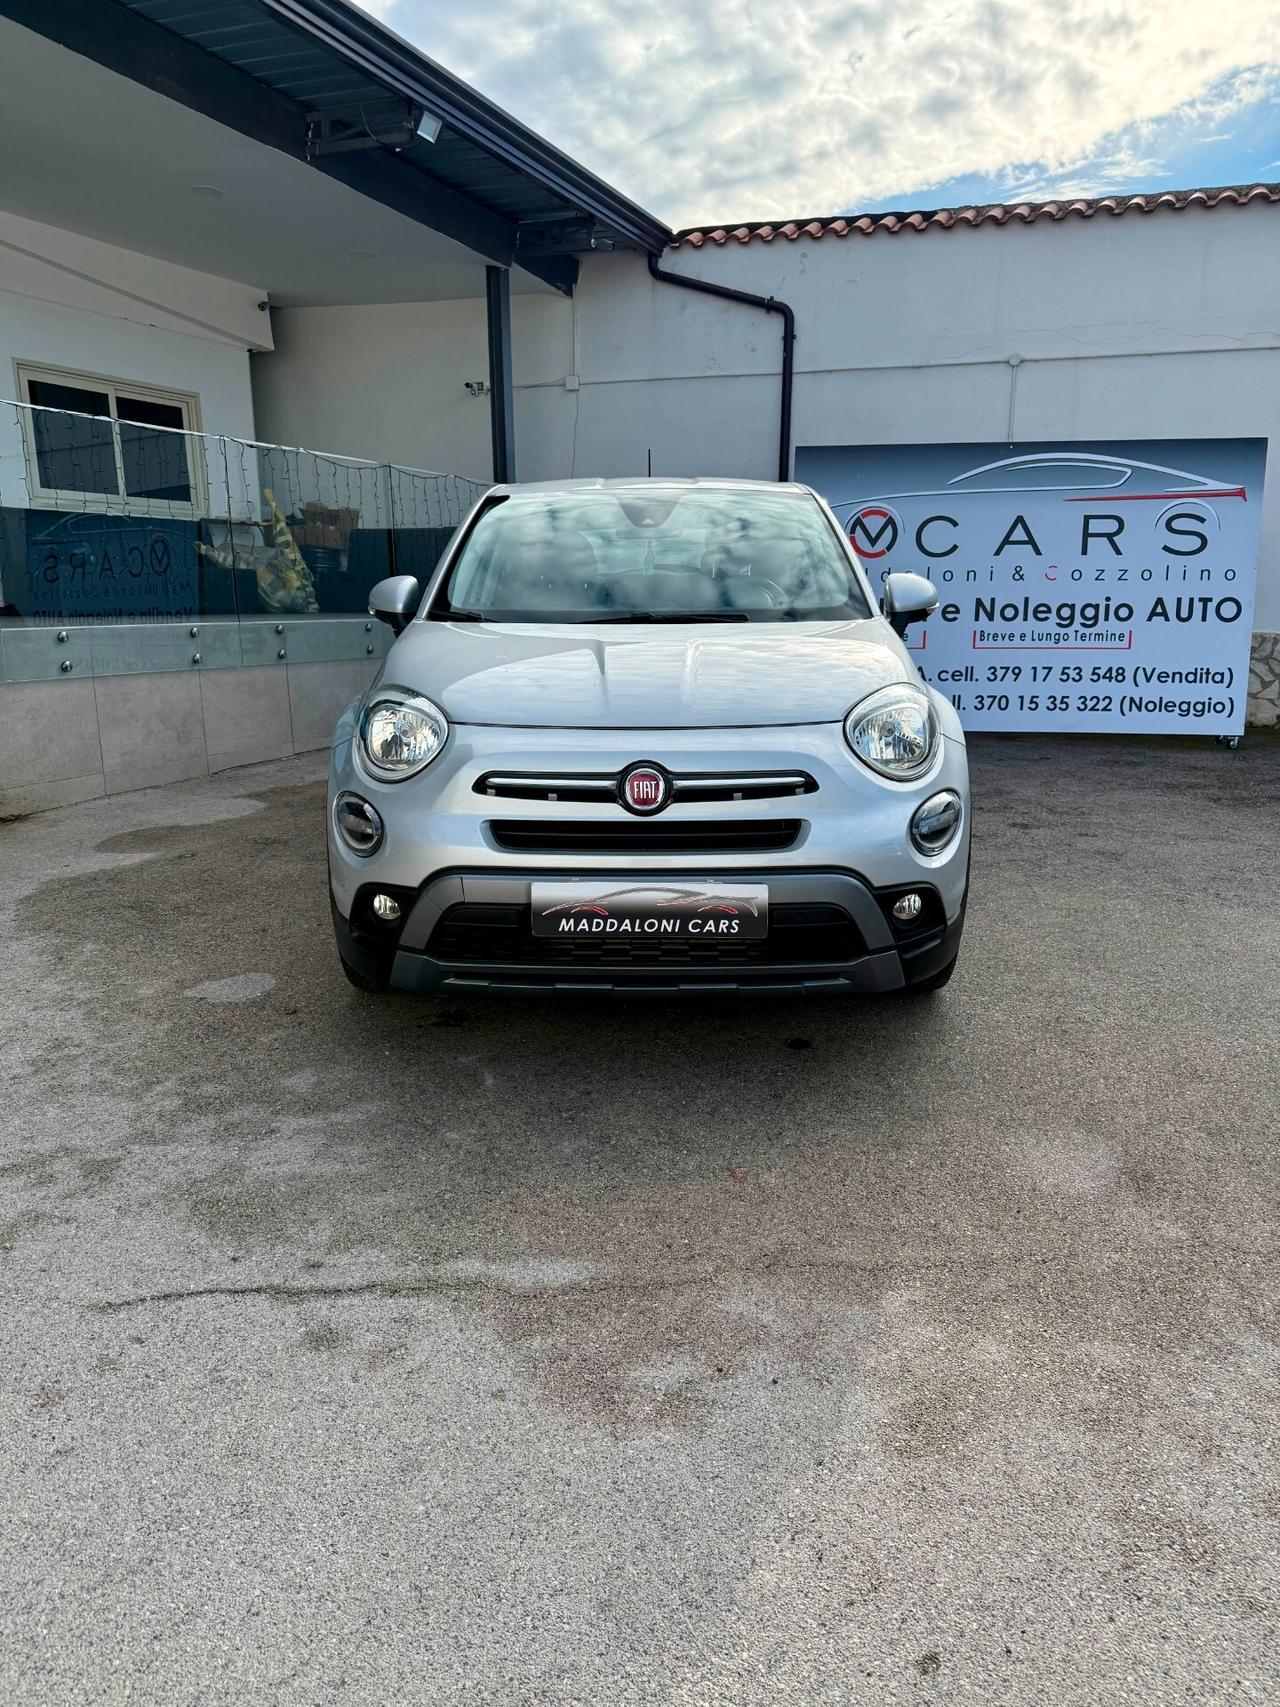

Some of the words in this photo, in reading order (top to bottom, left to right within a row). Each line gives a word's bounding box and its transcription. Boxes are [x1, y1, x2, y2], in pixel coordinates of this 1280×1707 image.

[915, 513, 1209, 558] CARS
[1011, 564, 1026, 582] &
[1044, 564, 1237, 582] Cozzolino
[940, 602, 961, 623] e
[973, 596, 1134, 629] Noleggio
[1146, 596, 1243, 623] AUTO
[979, 629, 1015, 642] Breve
[1020, 632, 1027, 642] e
[1031, 630, 1070, 644] Lungo
[1074, 630, 1126, 642] Termine
[937, 666, 979, 682] cell.
[986, 666, 1022, 682] 379
[1030, 666, 1053, 682] 17
[1059, 667, 1083, 683] 53
[1089, 667, 1126, 683] 548
[1132, 667, 1234, 689] (Vendita)
[974, 694, 1010, 711] 370
[1018, 695, 1039, 711] 15
[1046, 695, 1070, 711] 35
[1076, 695, 1113, 711] 322
[1119, 696, 1235, 718] (Noleggio)
[633, 780, 657, 799] FIAT
[558, 918, 681, 933] MADDALONI
[688, 918, 740, 934] CARS
